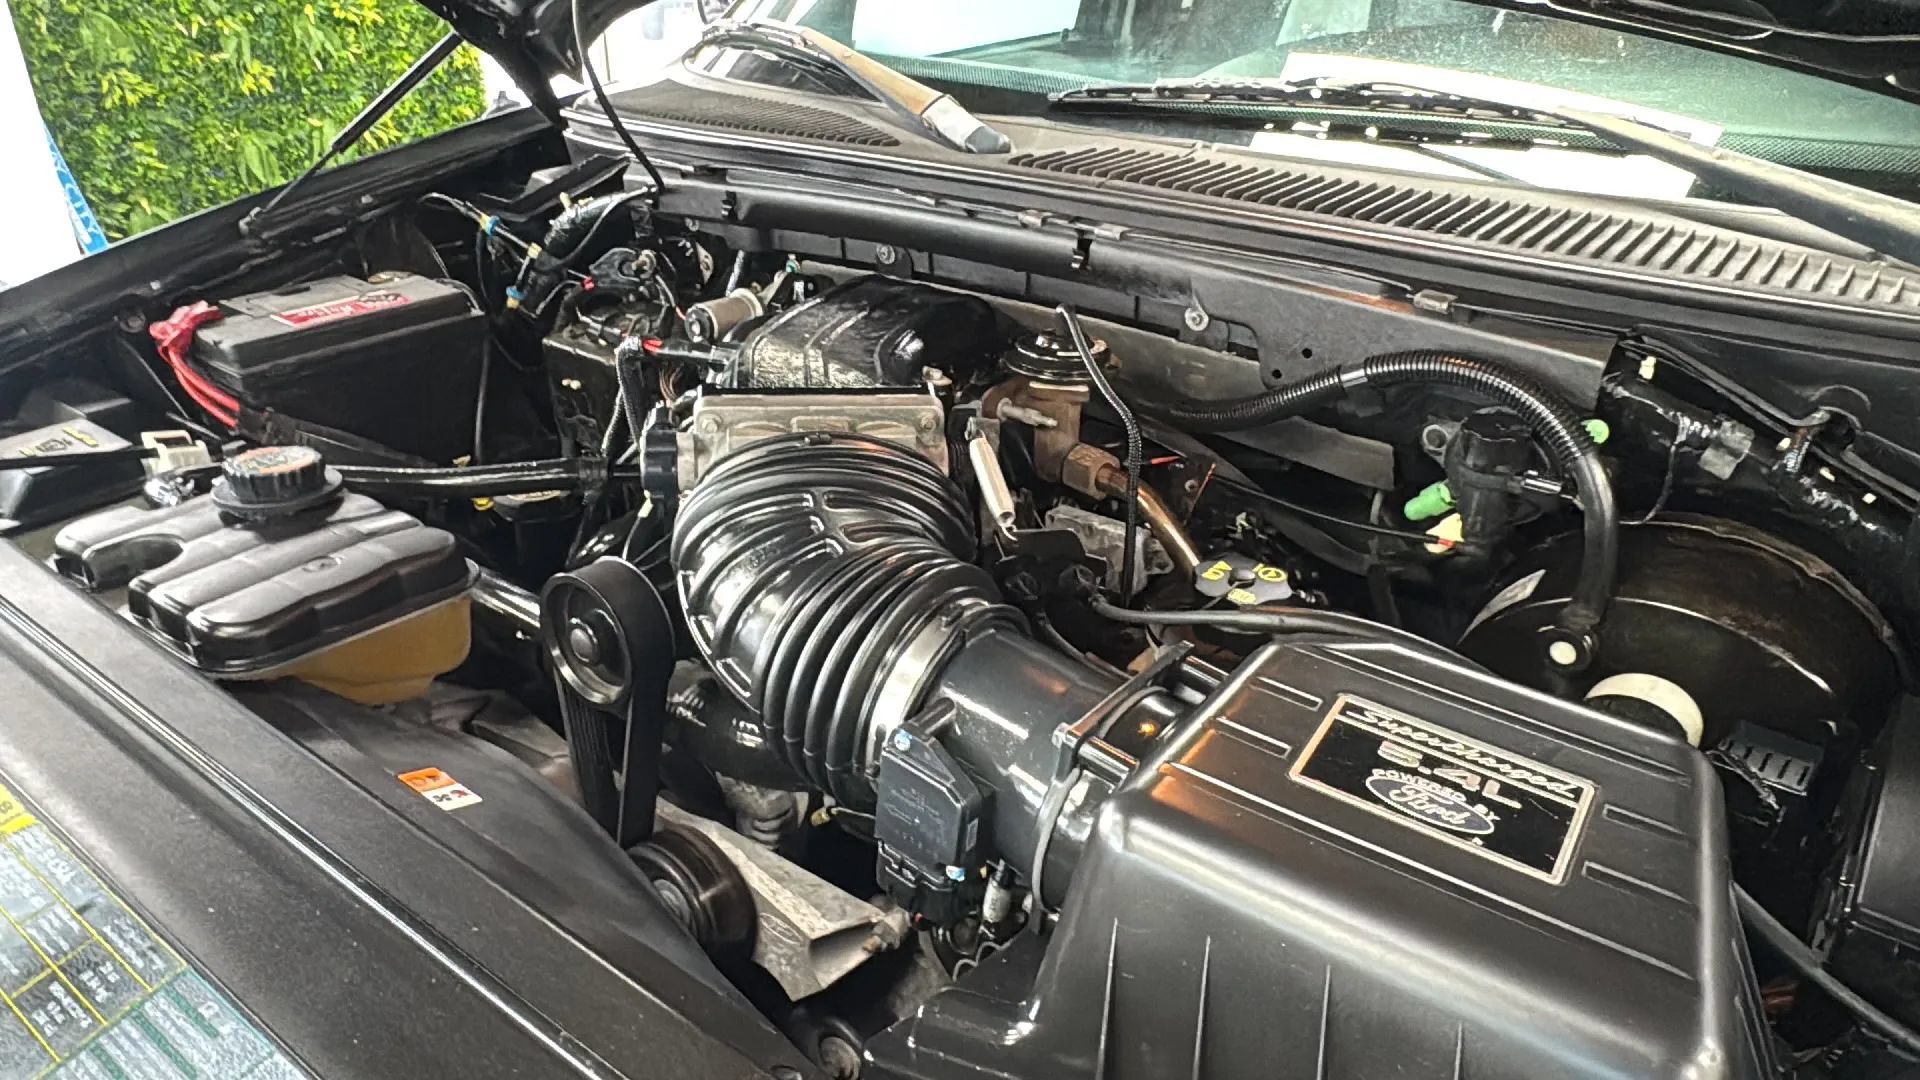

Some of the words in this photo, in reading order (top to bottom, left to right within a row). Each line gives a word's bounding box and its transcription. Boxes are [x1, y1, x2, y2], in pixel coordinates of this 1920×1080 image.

[1345, 710, 1575, 799] Supercharged
[1377, 740, 1522, 809] 5.4L
[1371, 768, 1468, 803] POWERED
[1473, 803, 1502, 822] BY
[1388, 785, 1467, 826] Ford
